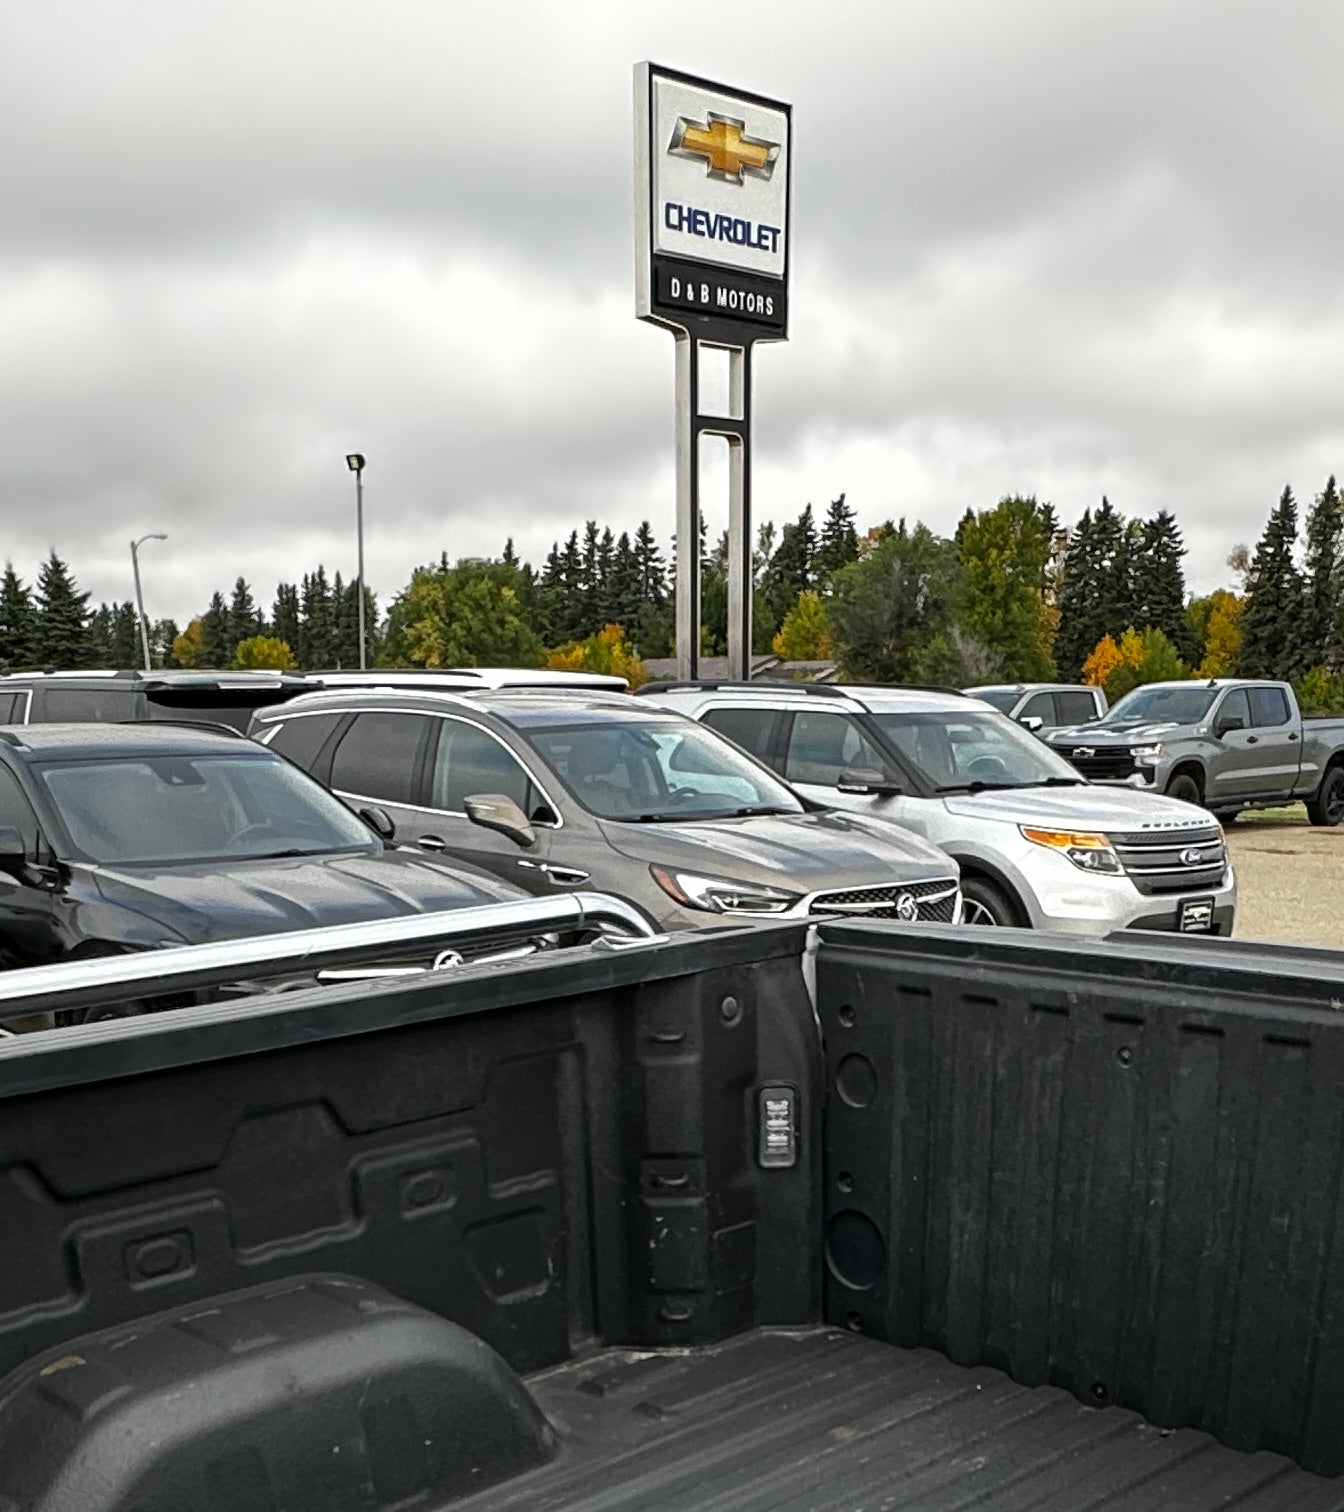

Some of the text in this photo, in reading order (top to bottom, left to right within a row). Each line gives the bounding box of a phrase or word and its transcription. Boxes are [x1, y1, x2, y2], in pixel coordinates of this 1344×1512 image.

[665, 202, 781, 253] CHEVROLET
[671, 277, 774, 316] D & B MOTORS
